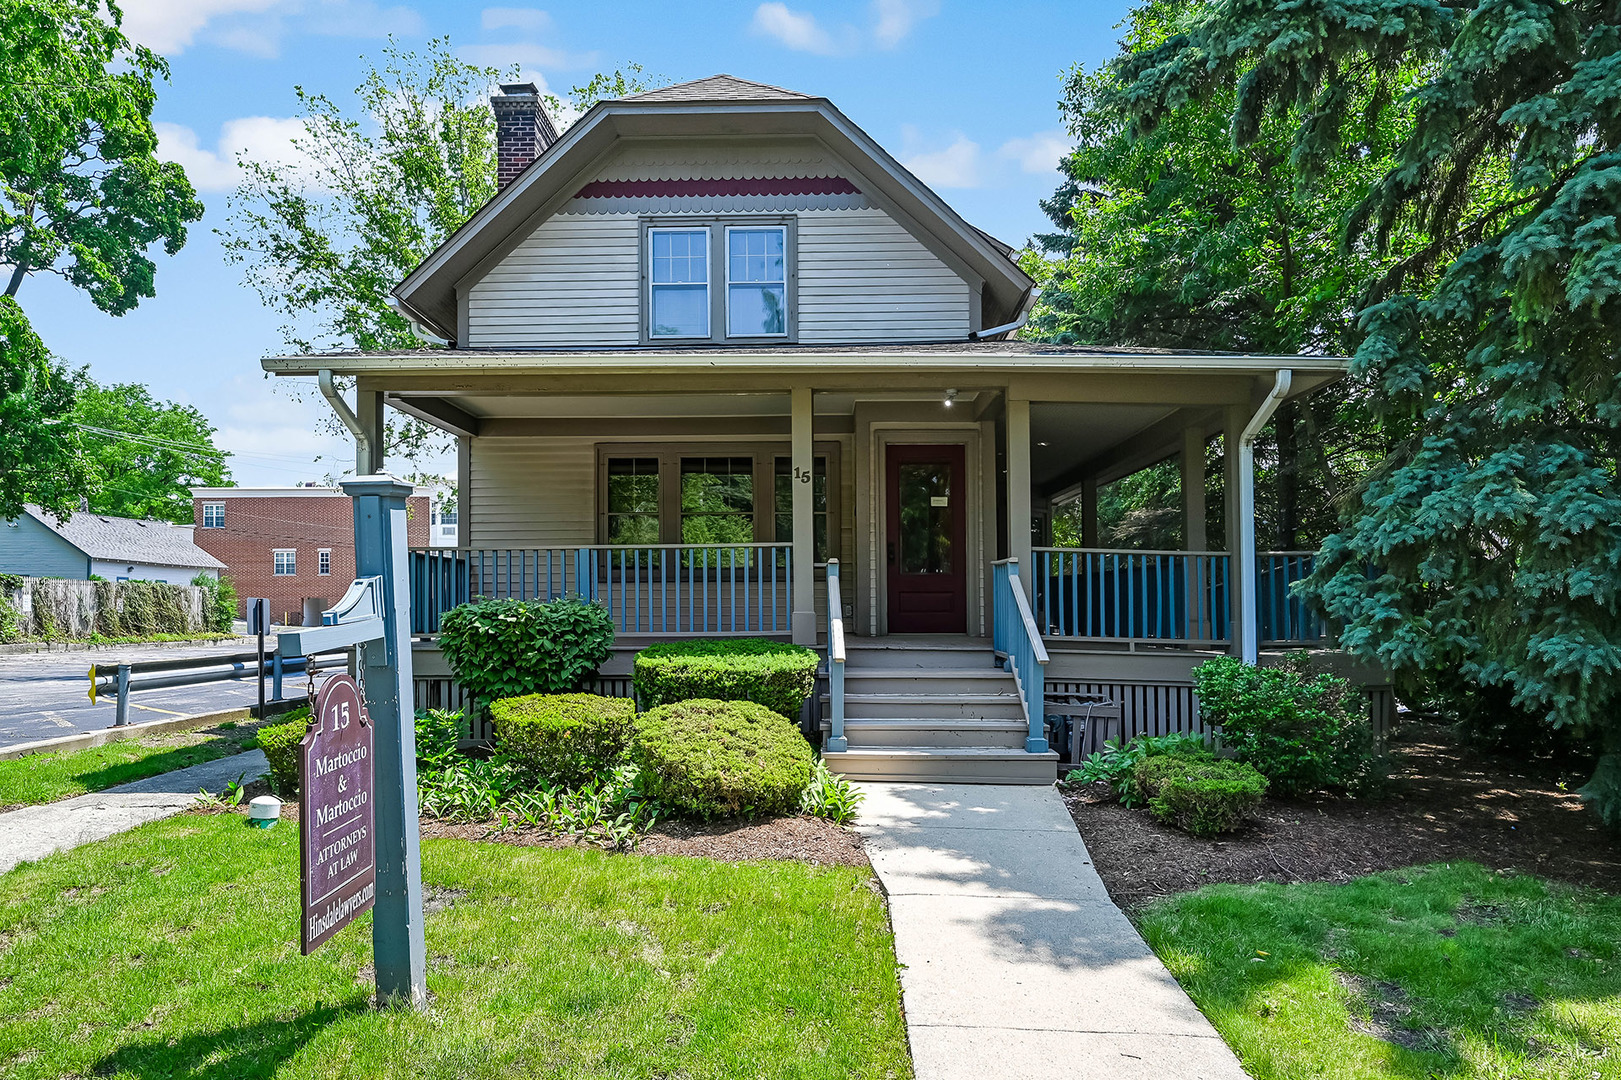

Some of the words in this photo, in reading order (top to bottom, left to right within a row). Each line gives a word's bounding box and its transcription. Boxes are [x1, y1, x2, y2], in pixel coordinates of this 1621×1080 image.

[794, 466, 811, 483] 15
[331, 701, 350, 731] 15
[315, 742, 367, 778] Martoccio
[337, 774, 347, 793] &
[315, 788, 367, 828] Martoccio
[316, 825, 367, 866] ATTORNEYS
[327, 859, 340, 880] AT
[340, 848, 359, 871] LAW
[308, 881, 374, 942] Hinsdalelawyers.com
